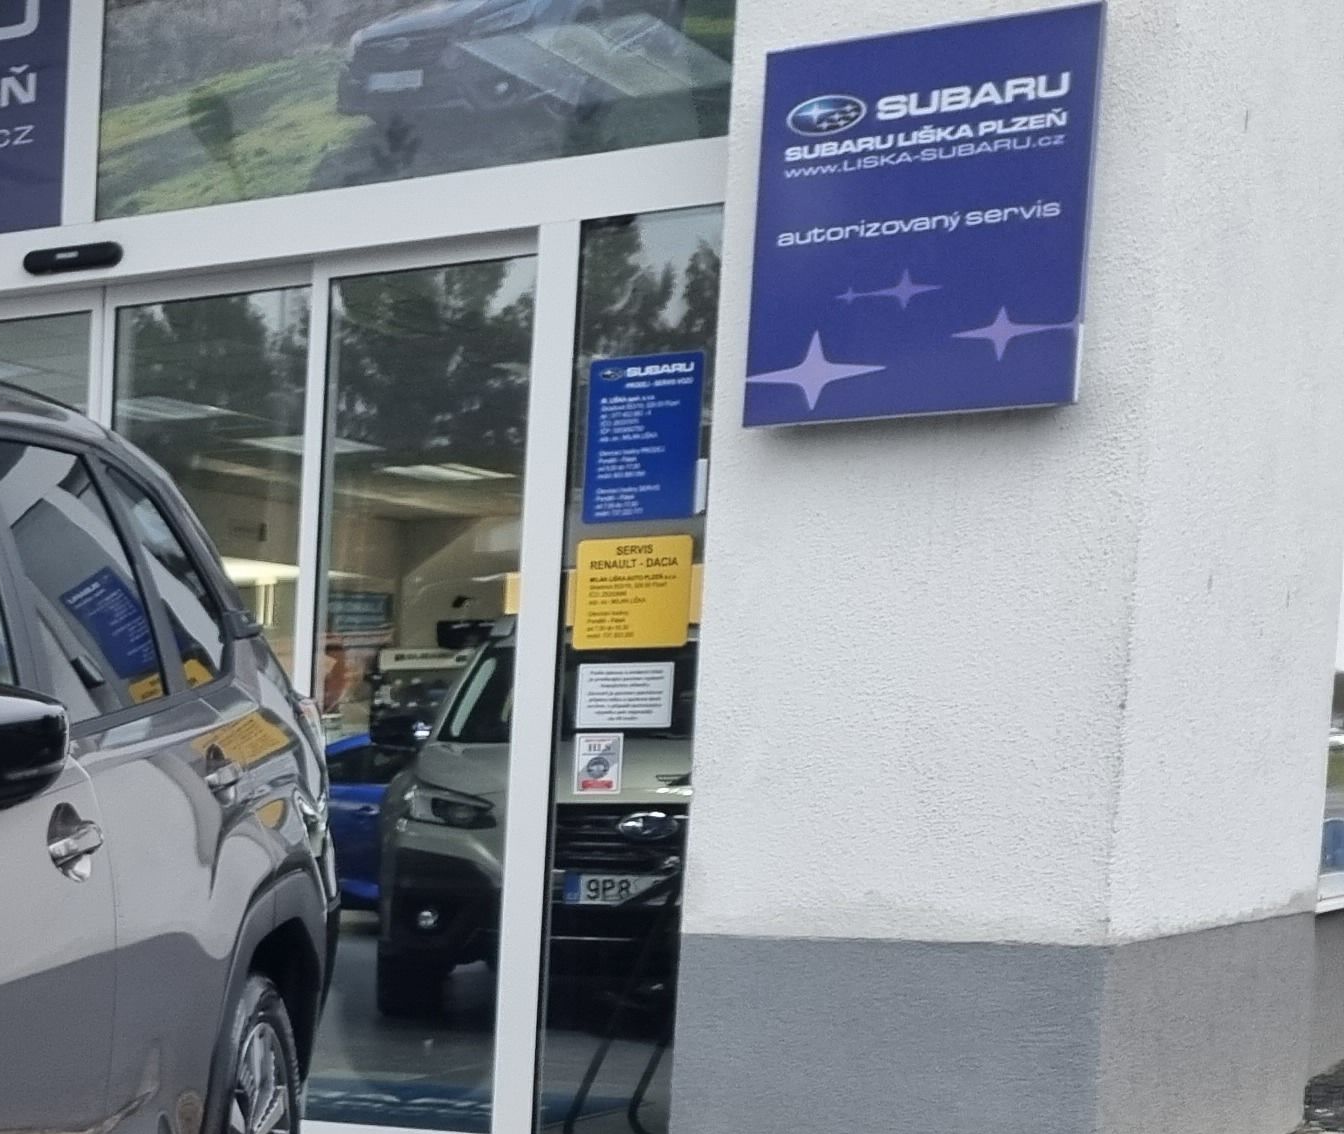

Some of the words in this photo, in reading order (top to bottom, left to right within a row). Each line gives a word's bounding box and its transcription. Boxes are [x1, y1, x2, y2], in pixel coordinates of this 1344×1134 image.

[876, 71, 1072, 121] SUBARU
[784, 132, 895, 163] SUBARU
[897, 121, 974, 148] LIŠKA
[978, 107, 1068, 137] PLZEŇ
[784, 132, 1067, 180] www.LISKA-SUBARU.cz
[776, 210, 961, 248] autorizovaný
[964, 198, 1062, 226] servis
[625, 361, 696, 378] SUBARU
[590, 558, 637, 570] RENAULT
[646, 557, 679, 568] DACIA
[616, 544, 654, 556] SERVIS
